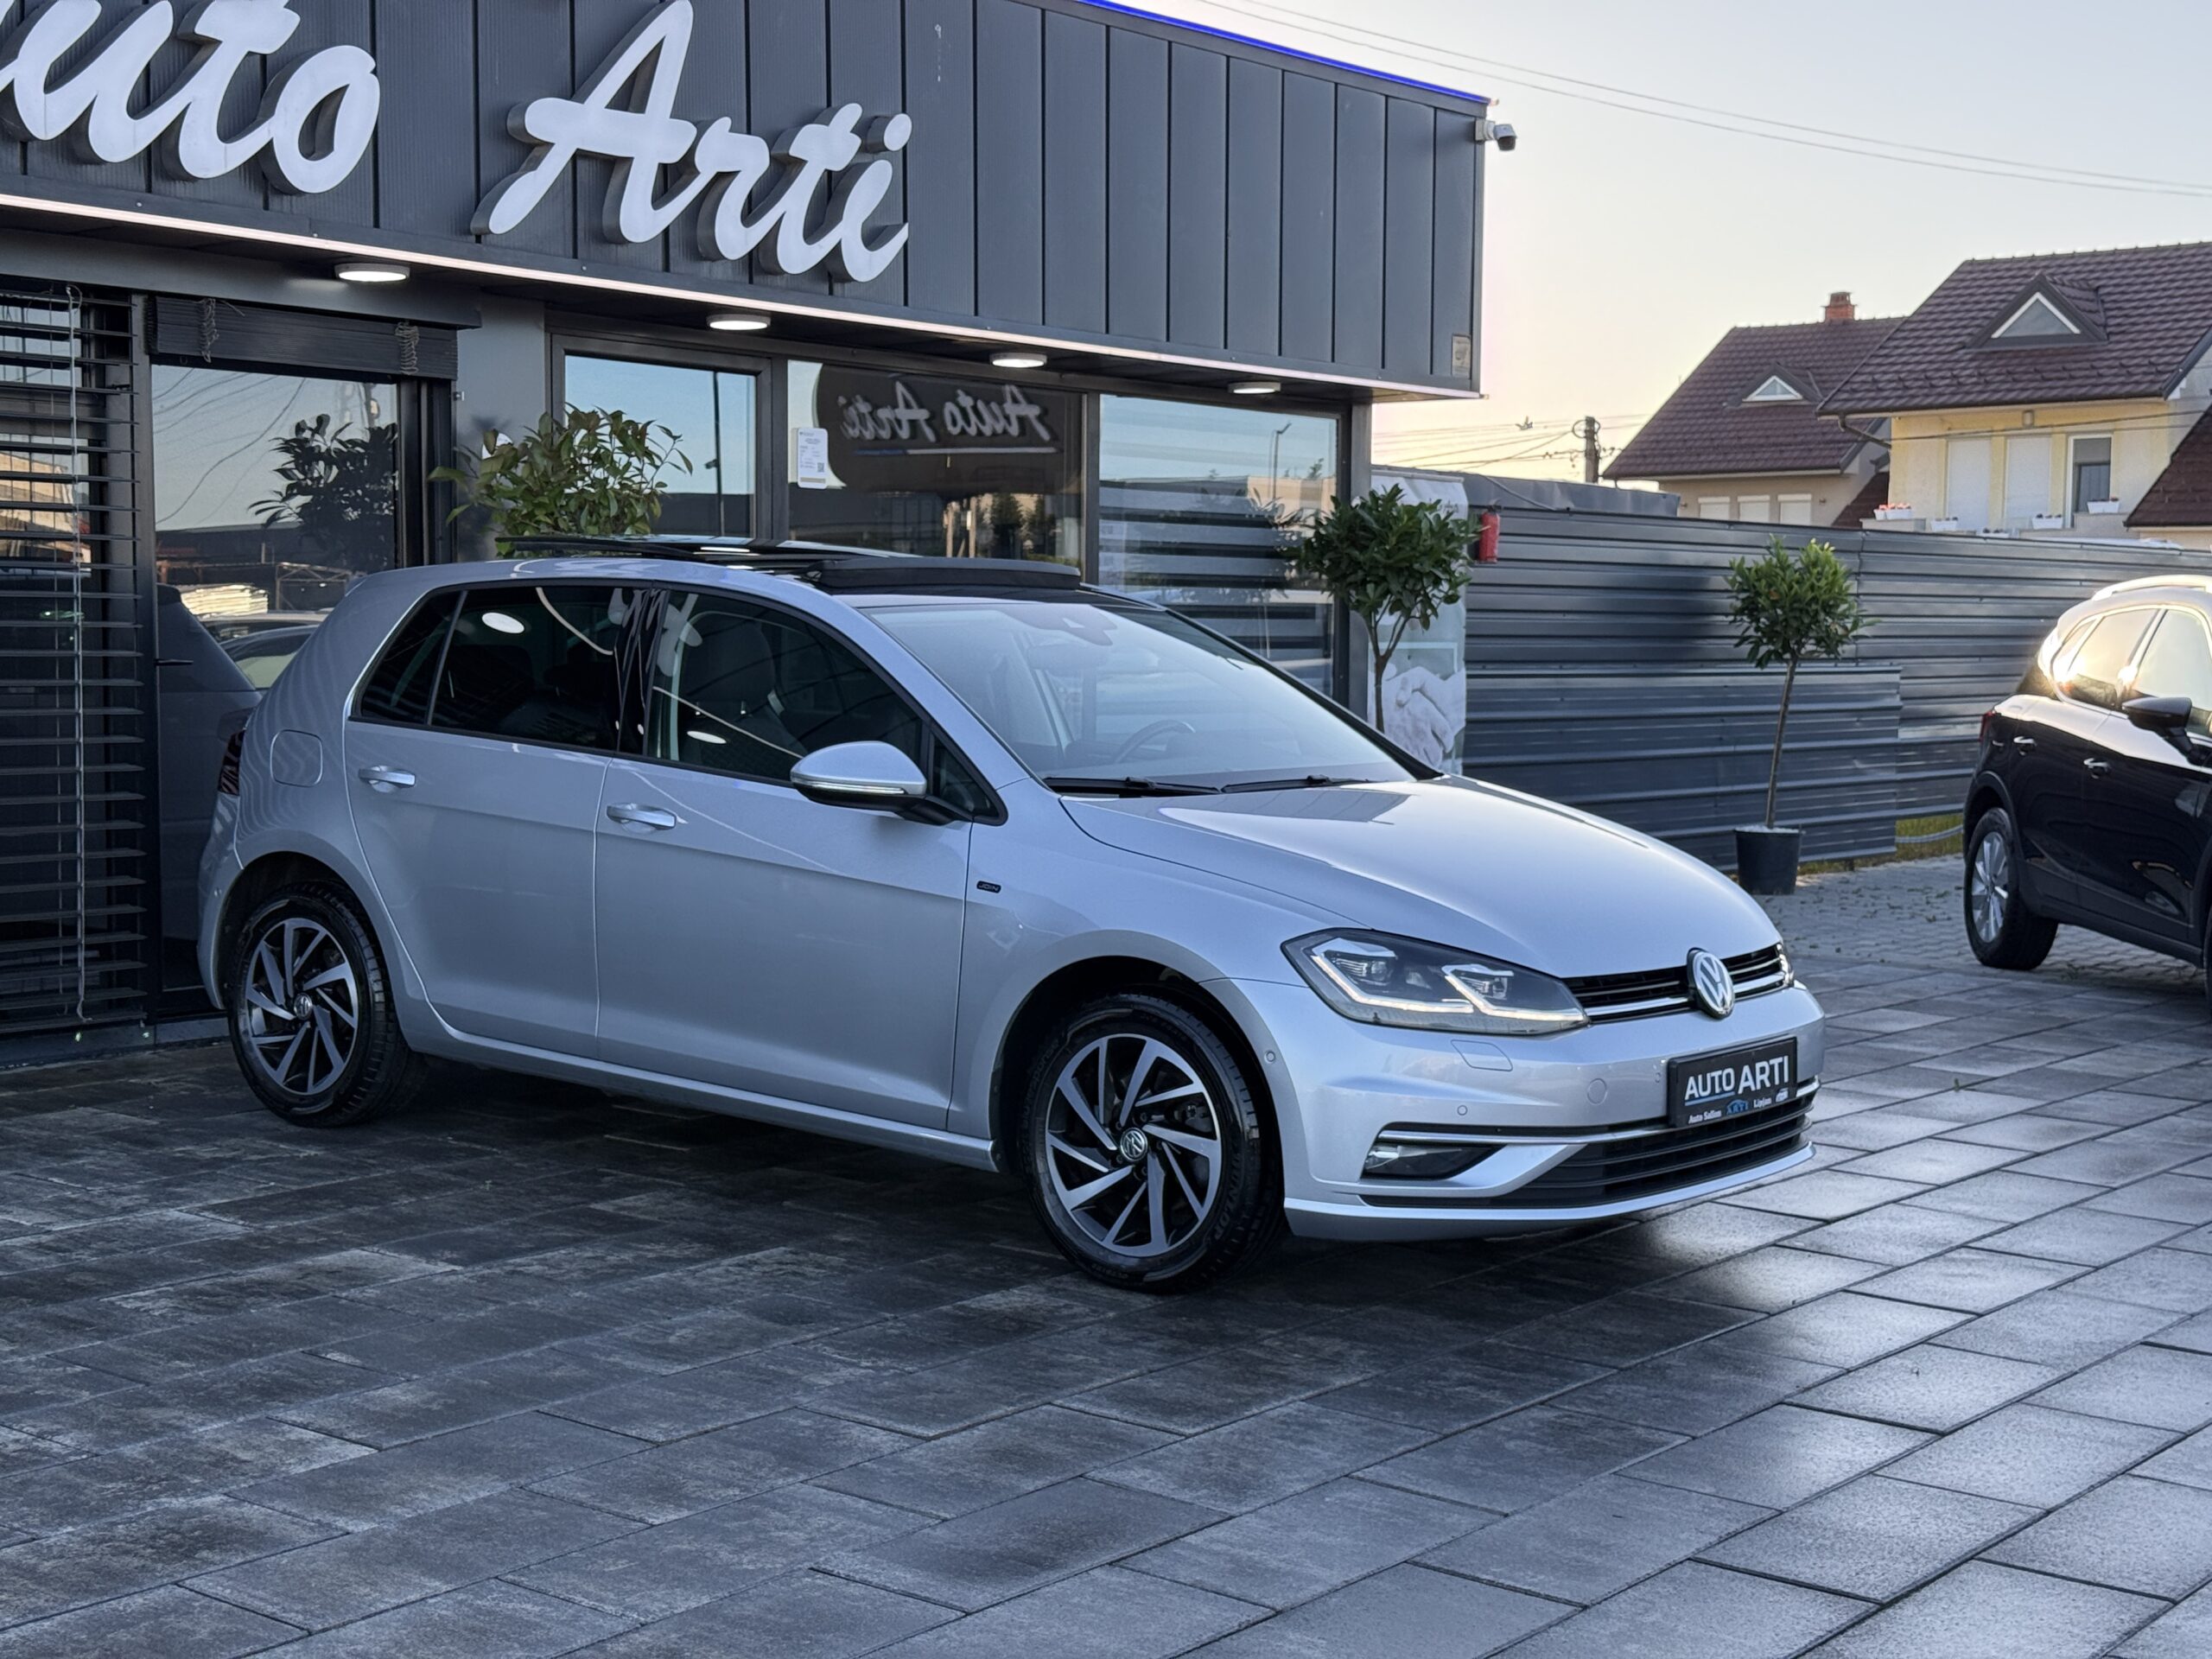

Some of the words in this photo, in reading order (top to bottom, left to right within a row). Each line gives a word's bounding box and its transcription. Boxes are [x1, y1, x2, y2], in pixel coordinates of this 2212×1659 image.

[0, 0, 380, 195] uto
[486, 0, 912, 283] Arti
[1685, 1067, 1735, 1101] AUTO
[1738, 1055, 1789, 1095] ARTI
